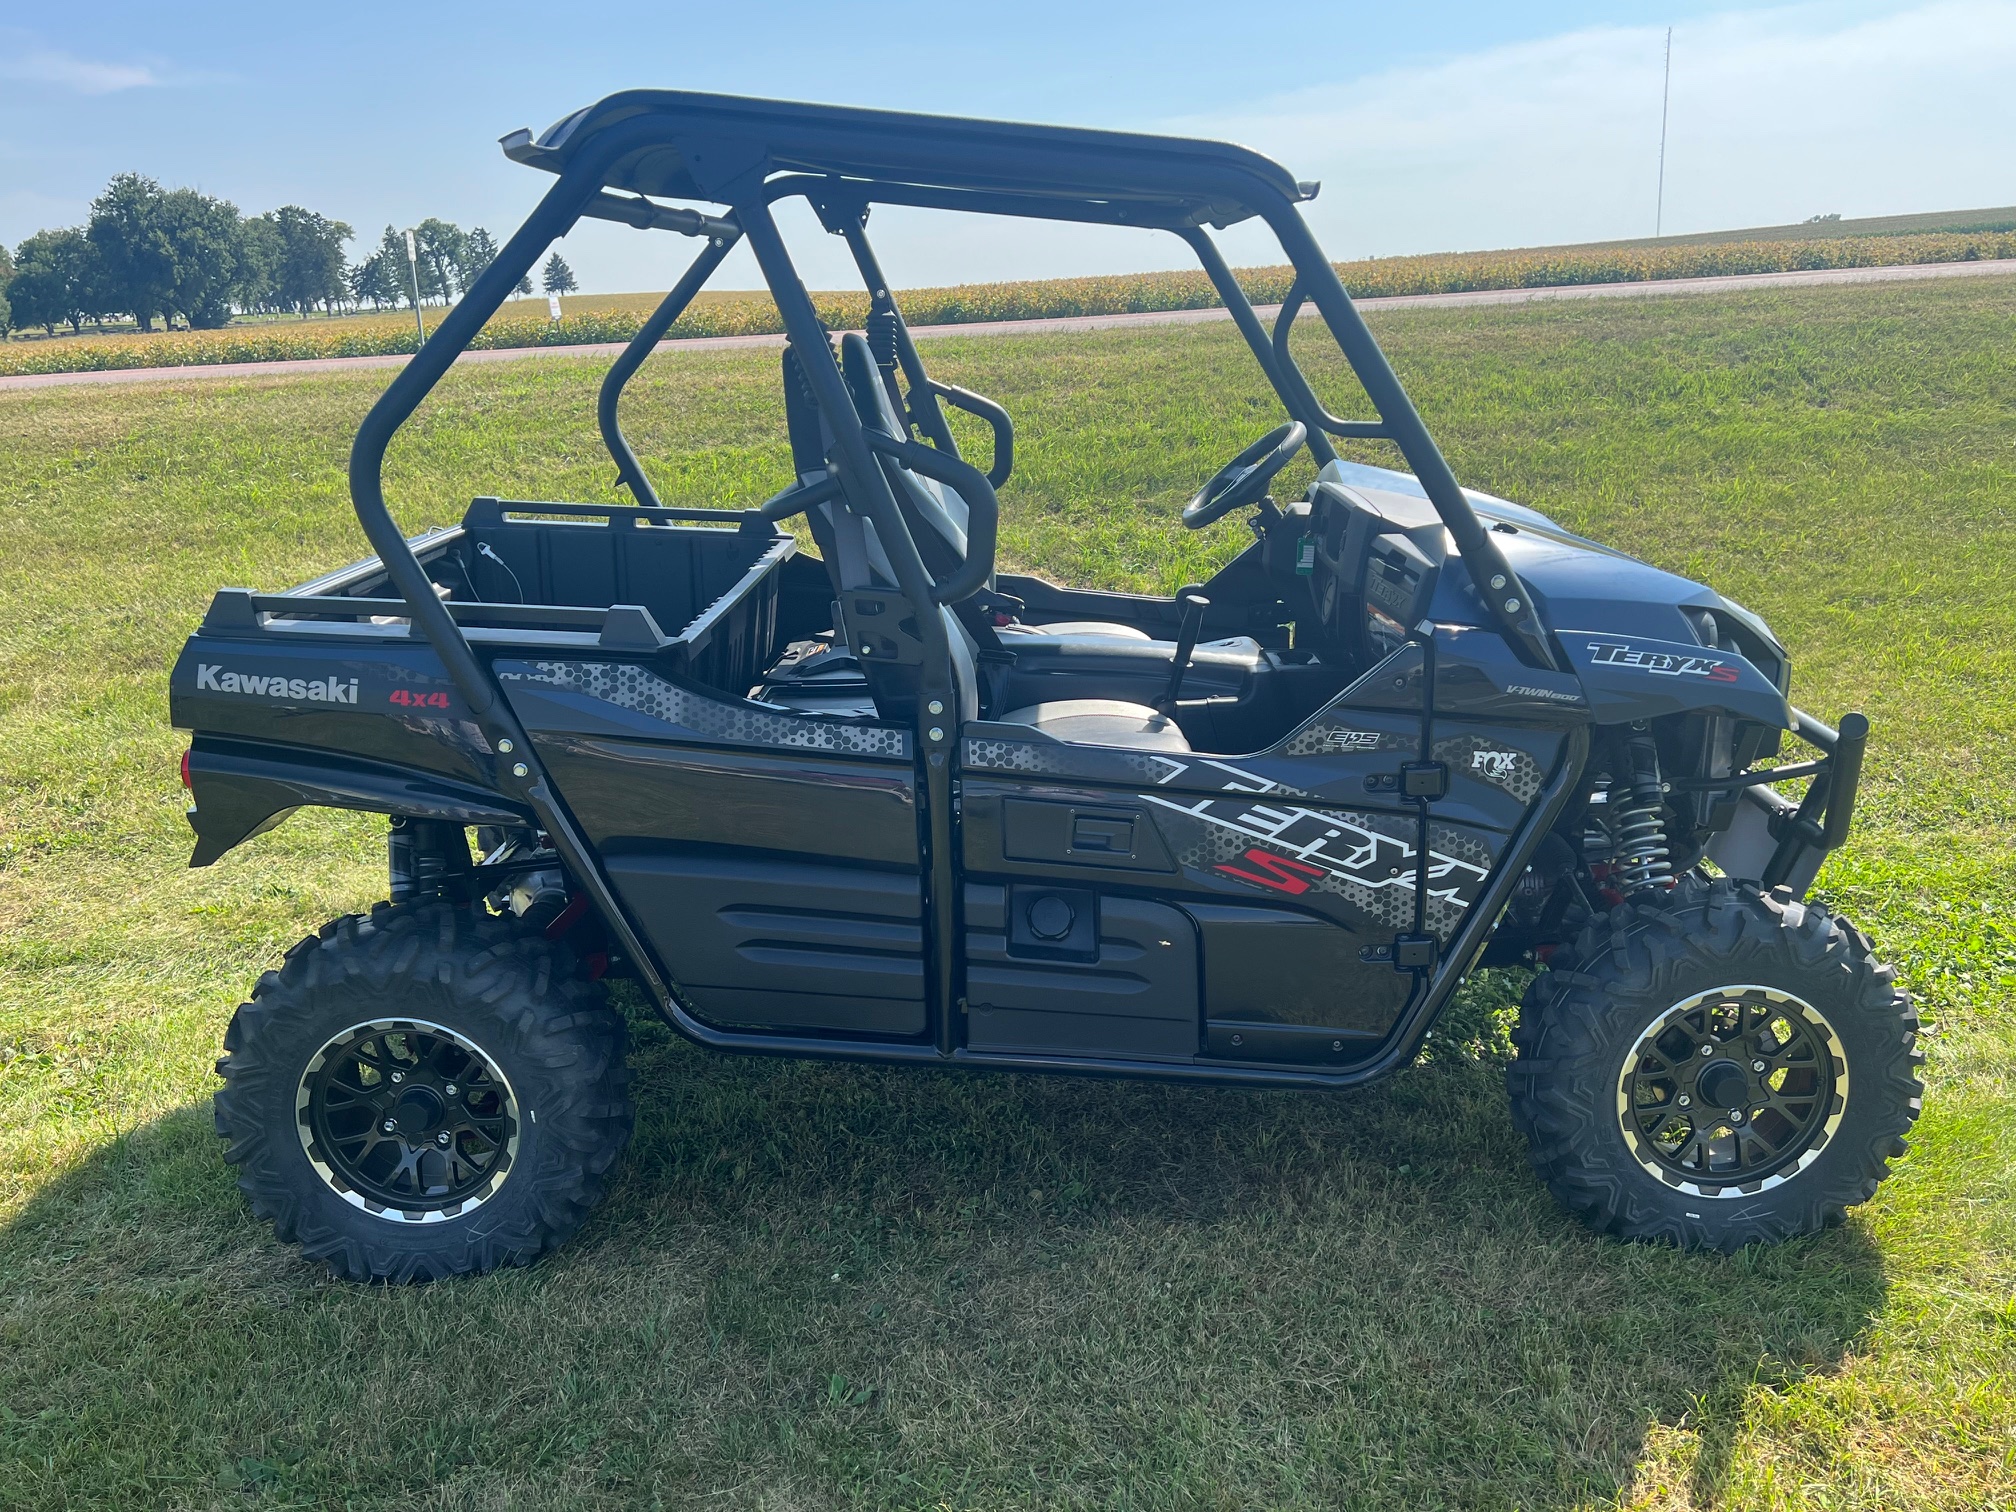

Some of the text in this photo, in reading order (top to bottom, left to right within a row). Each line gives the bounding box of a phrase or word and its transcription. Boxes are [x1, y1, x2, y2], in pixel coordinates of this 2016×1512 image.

[197, 663, 359, 704] Kawasaki
[389, 690, 450, 708] 4x4
[1327, 731, 1380, 746] EPS
[1471, 751, 1517, 779] FOX
[1212, 848, 1325, 895] S
